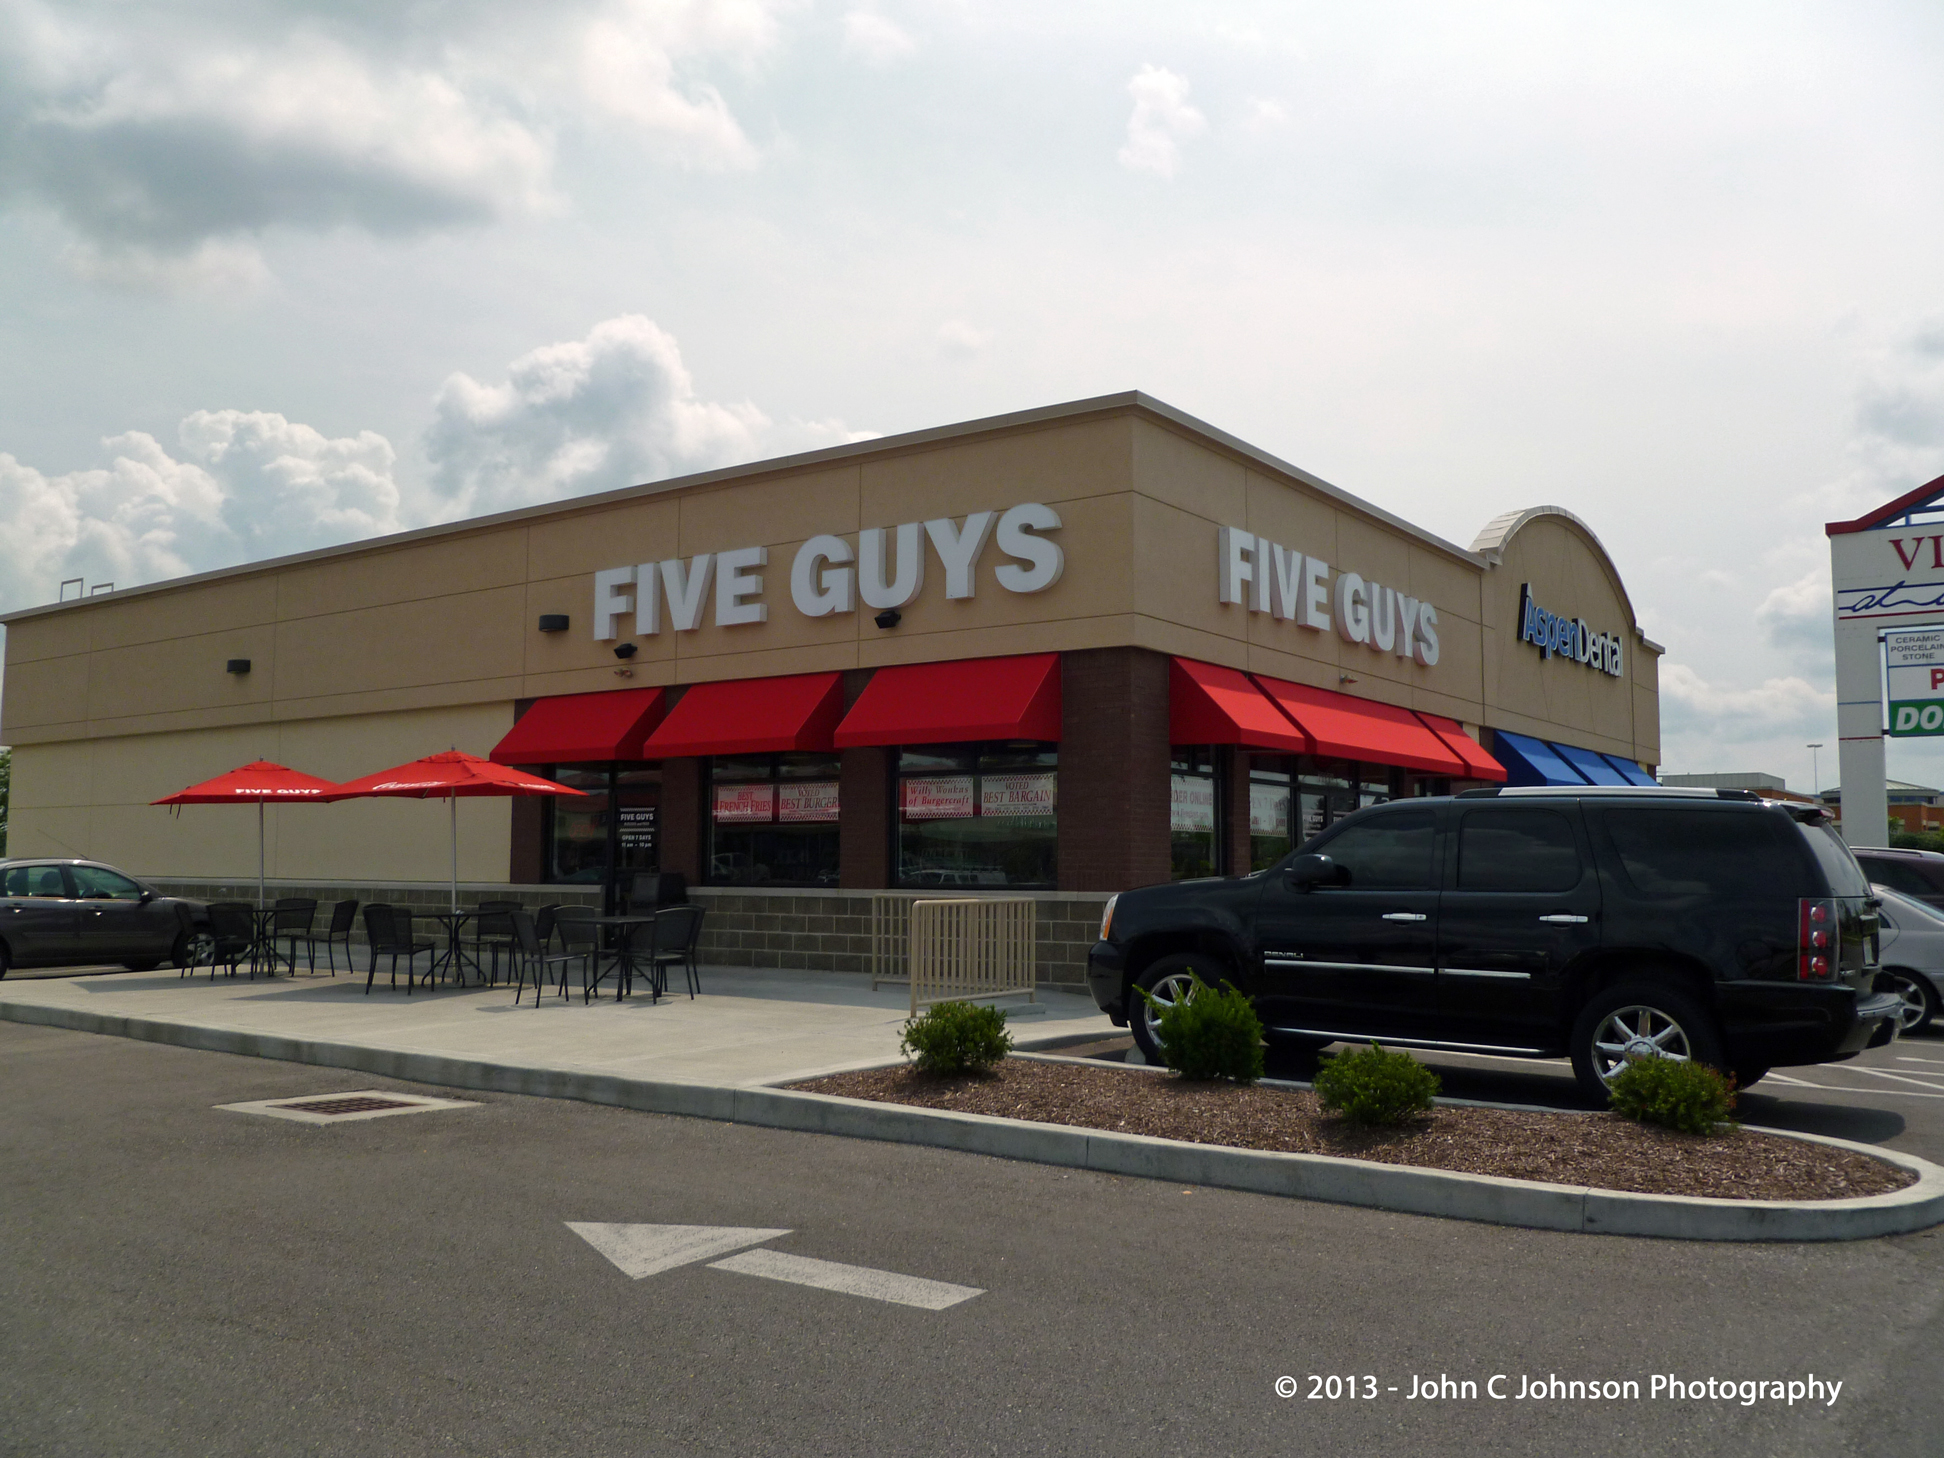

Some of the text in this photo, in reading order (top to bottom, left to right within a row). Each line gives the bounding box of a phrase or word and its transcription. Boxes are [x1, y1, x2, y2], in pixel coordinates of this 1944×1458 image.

[594, 502, 1065, 641] FIVE GUYS
[1219, 526, 1440, 666] FIVE GUYS
[1895, 635, 1941, 644] CERAMIC
[1902, 652, 1936, 661] STONE
[1895, 705, 1944, 731] DO
[936, 785, 969, 794] Wonkas
[1005, 781, 1029, 790] VOTED
[737, 791, 754, 800] BEST
[797, 788, 820, 797] VOTED
[983, 790, 1051, 803] BEST BARGAIN
[1171, 789, 1188, 804] DER
[720, 800, 750, 812] FRENCH
[750, 800, 772, 812] FRIES
[781, 797, 838, 810] BEST BURGER
[908, 796, 918, 807] of
[620, 813, 635, 821] FIVE
[1264, 950, 1304, 958] DENALI
